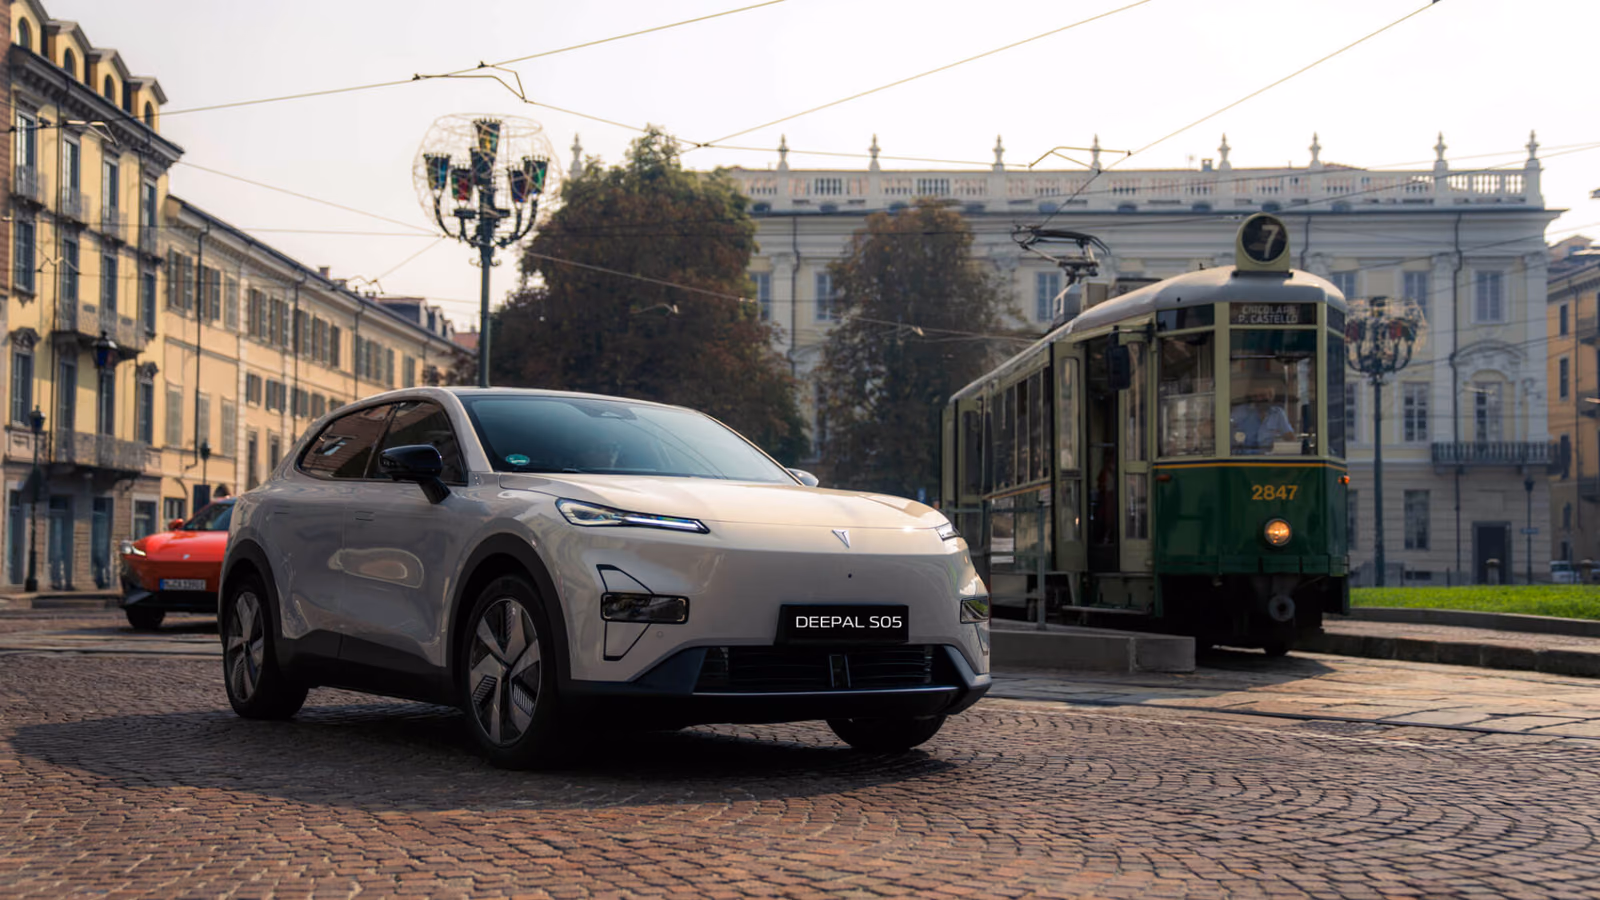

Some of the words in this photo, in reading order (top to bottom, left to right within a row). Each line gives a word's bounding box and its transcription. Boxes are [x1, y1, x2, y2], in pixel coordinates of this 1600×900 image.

[1261, 224, 1280, 259] 7
[1250, 314, 1298, 324] CASTELLO
[1251, 484, 1298, 500] 2847
[796, 616, 865, 628] DEEPAL
[869, 616, 902, 628] S05
